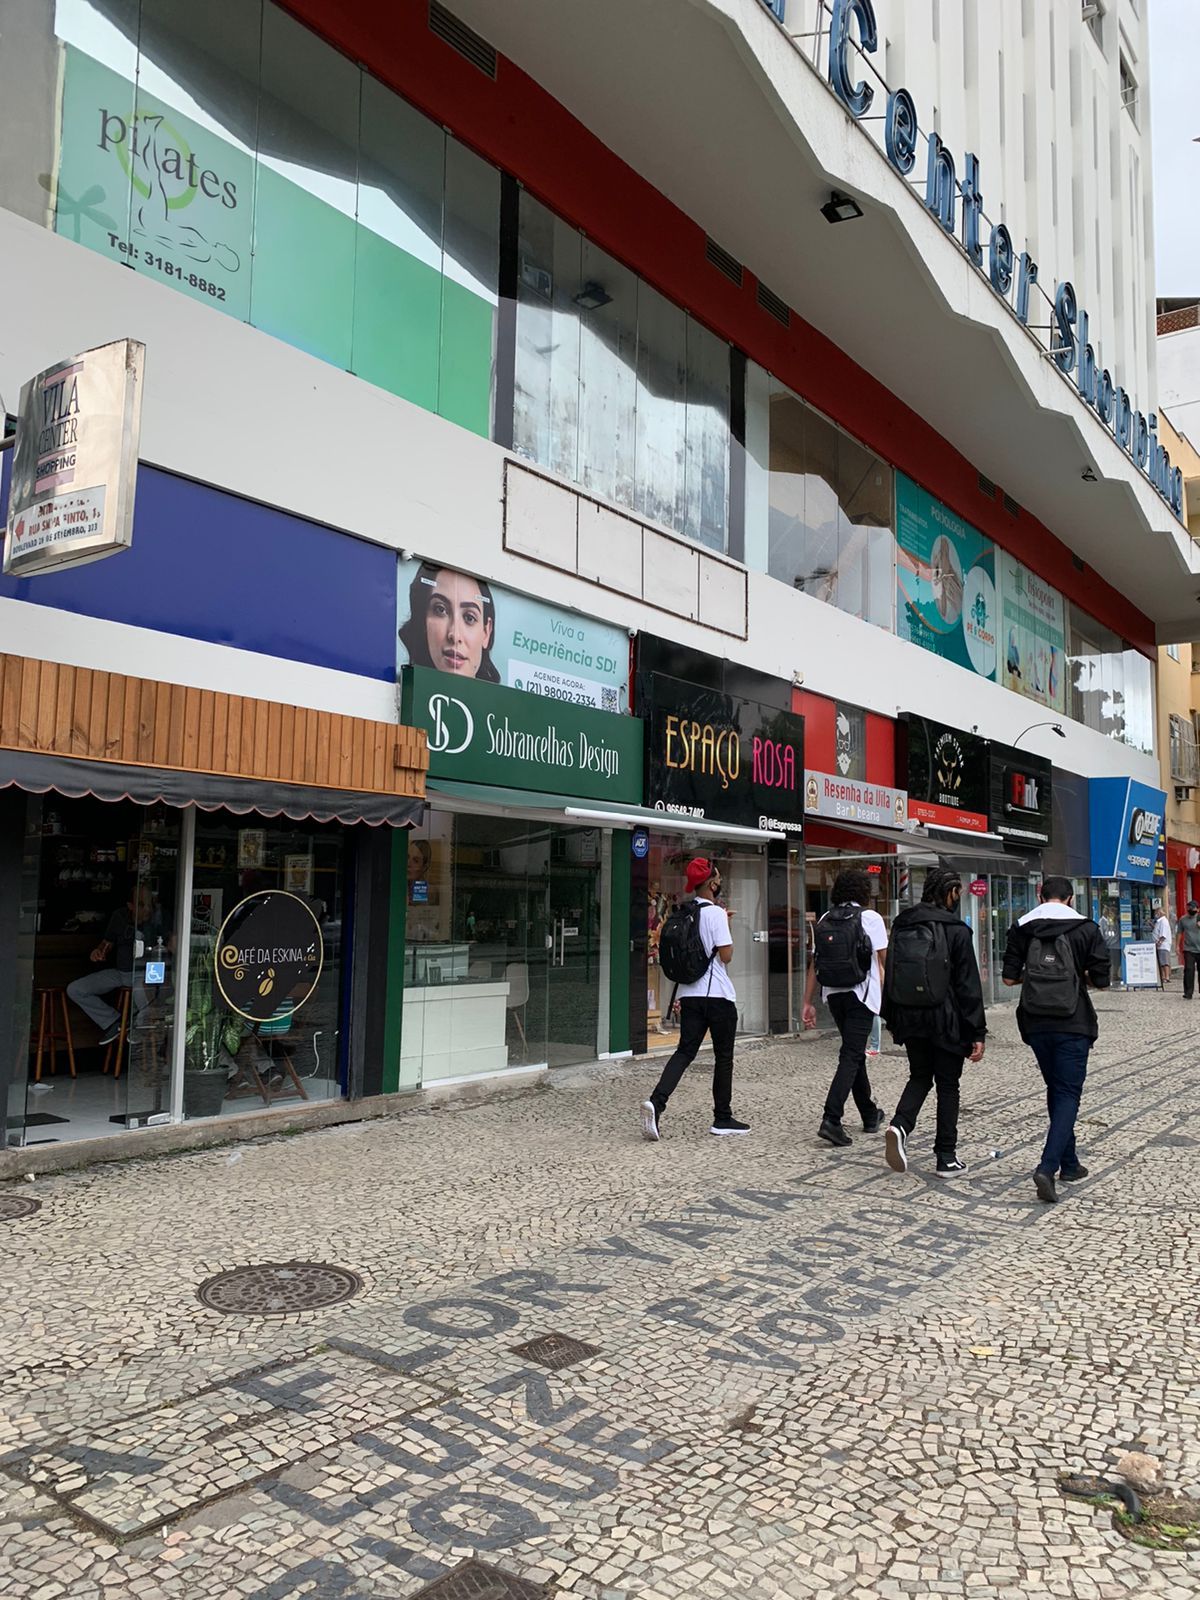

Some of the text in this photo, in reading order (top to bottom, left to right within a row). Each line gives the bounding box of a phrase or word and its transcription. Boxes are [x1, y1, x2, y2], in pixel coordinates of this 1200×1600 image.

[829, 0, 1037, 324] Center
[107, 232, 226, 301] Tel: 3181-8882
[43, 375, 80, 425] VILA
[39, 417, 78, 455] CENTER
[36, 454, 76, 478] SHOPPING
[550, 618, 585, 642] Viva a
[512, 630, 617, 674] Experiência SD!
[526, 680, 597, 708] (21) 98002-2334
[533, 671, 586, 691] AGENDE AGORA:
[486, 713, 574, 768] Sobrancelhas
[579, 732, 619, 779] Design
[665, 715, 795, 790] ESPAÇO ROSA
[824, 778, 860, 803] Resenha
[863, 788, 873, 805] da
[257, 948, 270, 963] DA
[272, 947, 303, 963] ESKINA
